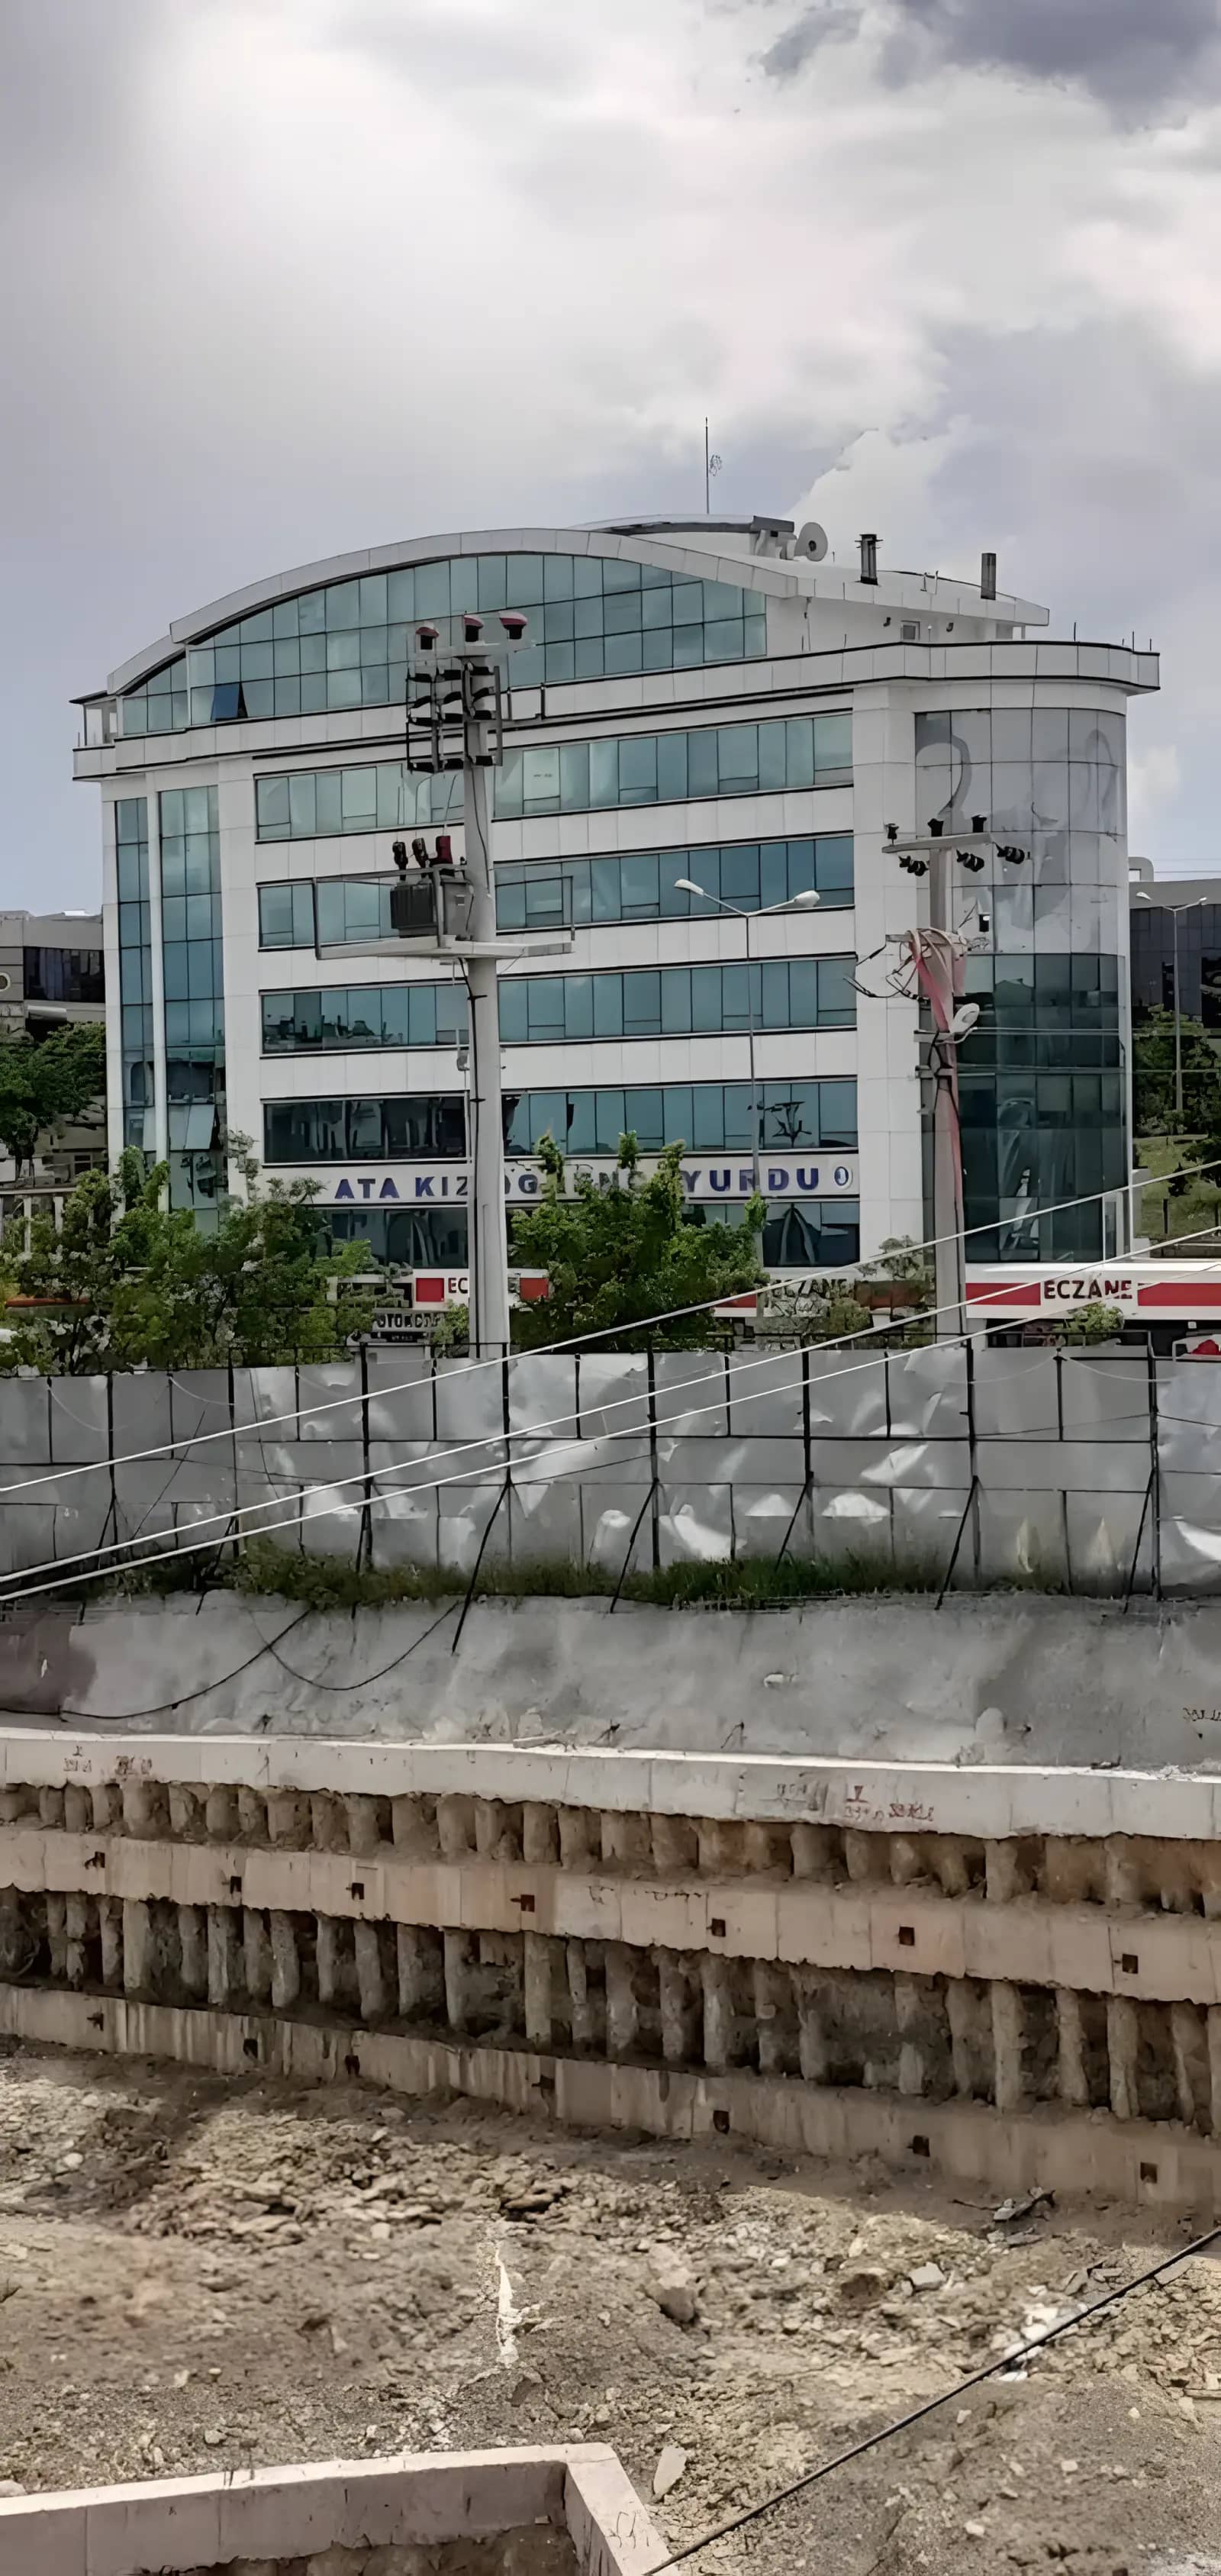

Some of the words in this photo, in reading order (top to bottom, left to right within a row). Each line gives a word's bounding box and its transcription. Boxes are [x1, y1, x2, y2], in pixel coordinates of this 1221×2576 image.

[334, 1178, 400, 1199] ATA
[414, 1176, 468, 1197] KIZ
[681, 1168, 819, 1192] YURDU
[1044, 1279, 1132, 1299] ECZANE
